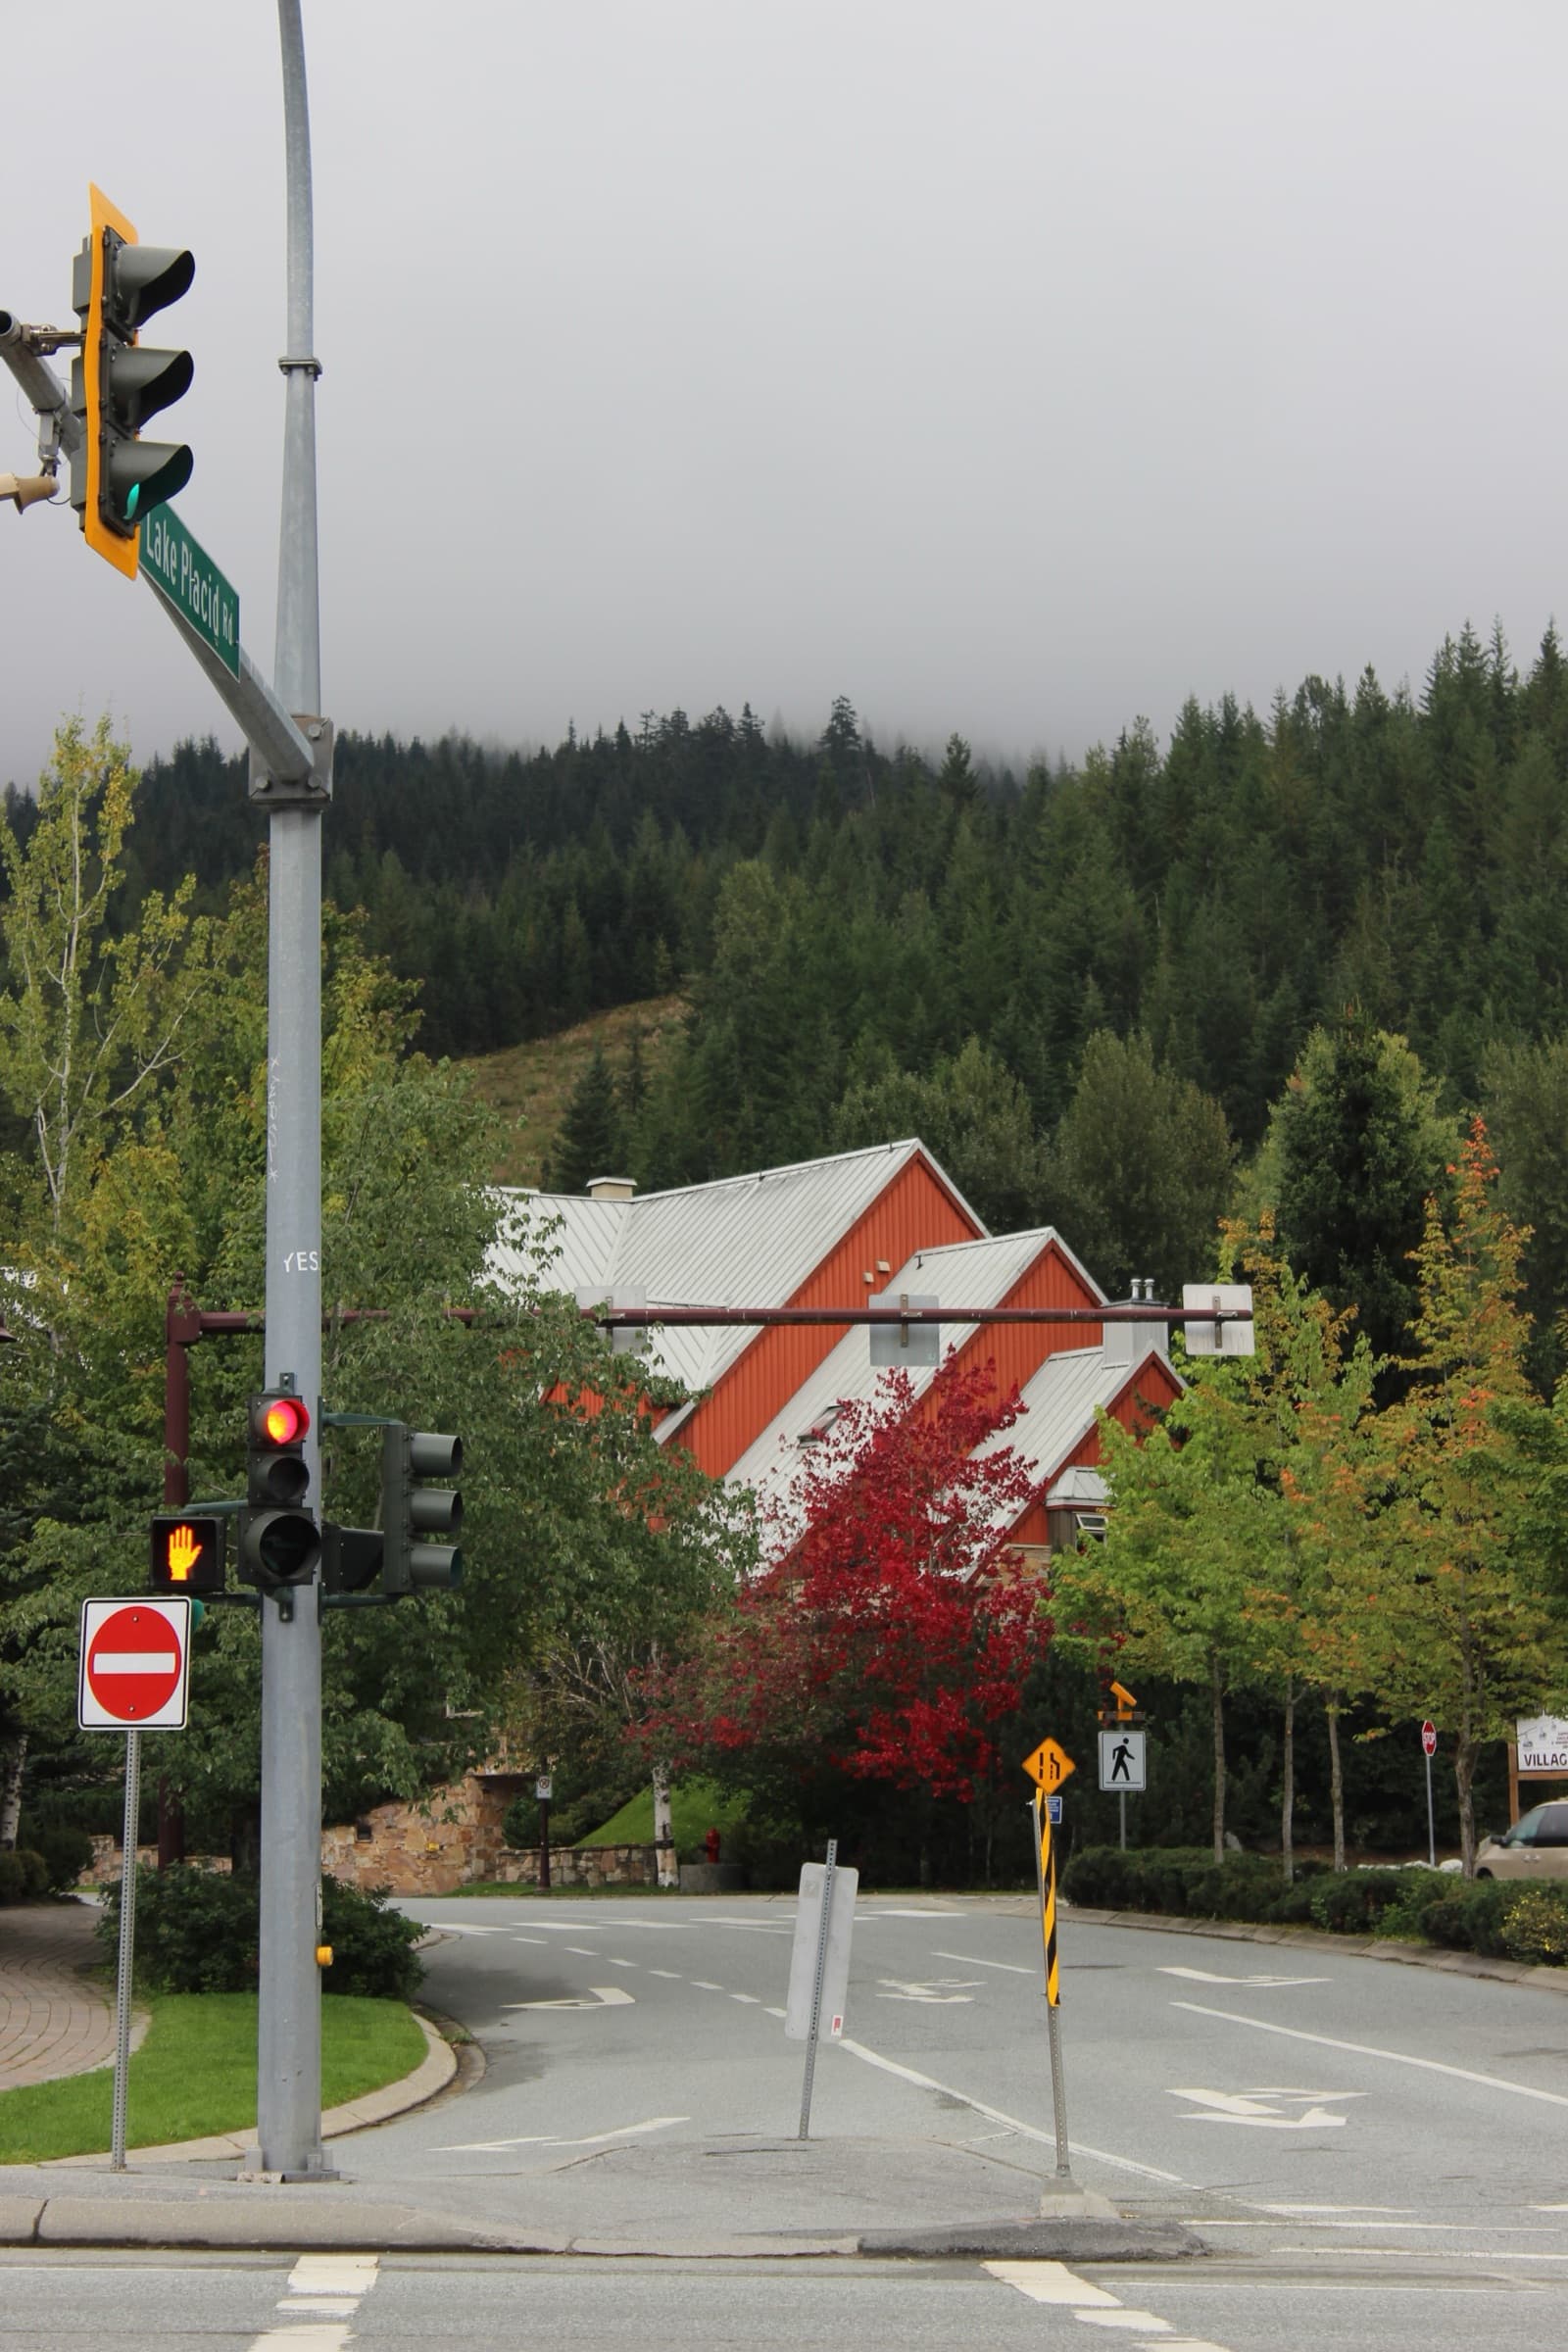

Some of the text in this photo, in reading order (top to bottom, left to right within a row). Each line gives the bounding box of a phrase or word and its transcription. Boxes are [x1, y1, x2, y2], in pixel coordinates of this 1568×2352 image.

[147, 512, 233, 646] Lake Placid Rd
[283, 1250, 318, 1273] YES
